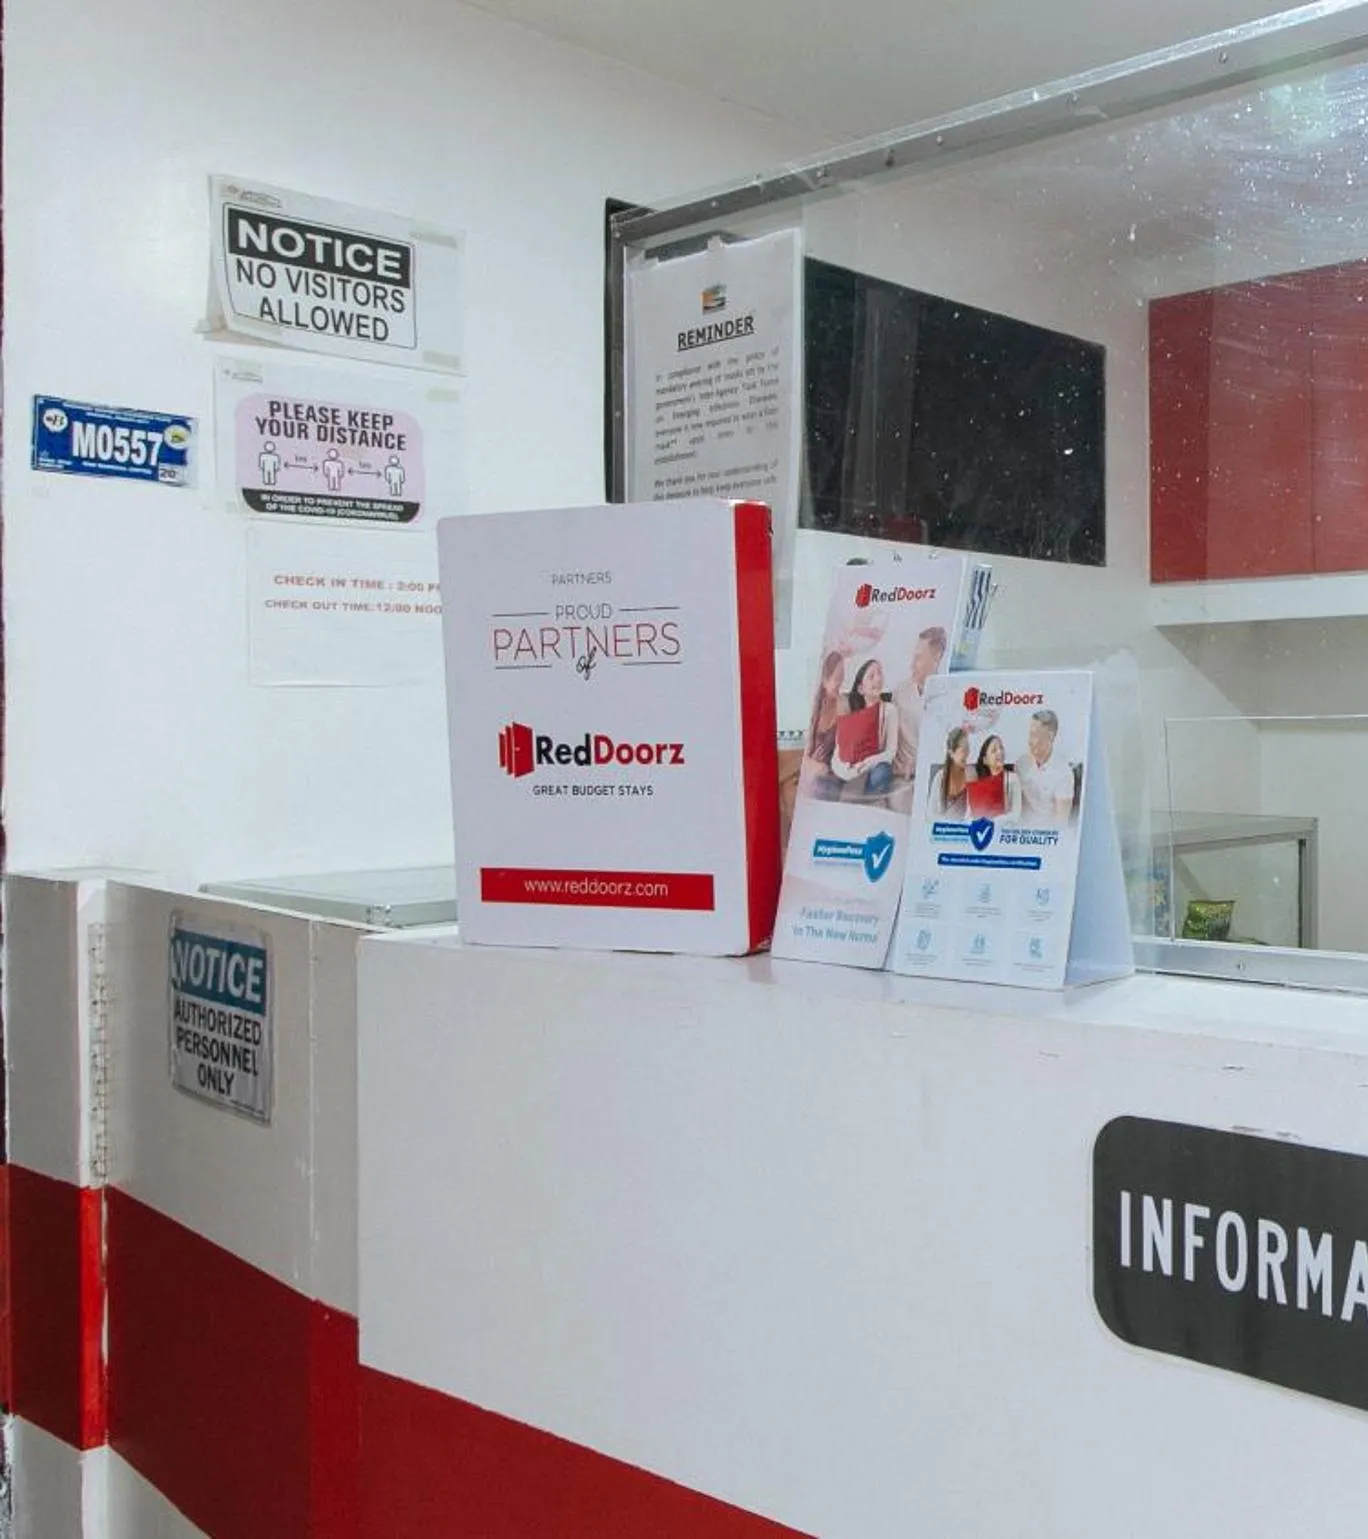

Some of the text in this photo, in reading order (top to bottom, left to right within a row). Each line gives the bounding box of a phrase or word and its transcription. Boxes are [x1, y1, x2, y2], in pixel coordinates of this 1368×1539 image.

[237, 218, 403, 280] NOTICE
[236, 258, 406, 314] NO VISITORS
[259, 296, 389, 342] ALLOWED
[677, 315, 754, 350] REMINDER
[268, 400, 394, 432] PLEASE KEEP
[255, 416, 407, 451] YOUR DISTANCE
[273, 574, 326, 588] CHECK
[331, 578, 346, 589] IN
[352, 578, 385, 590] TIME
[551, 570, 613, 586] PARTNERS
[871, 586, 937, 603] RedDoorz
[264, 598, 308, 610] CHECK
[312, 600, 338, 611] OUT
[555, 604, 613, 621] PROUD
[493, 622, 682, 662] PARTNERS
[575, 647, 598, 681] of
[978, 690, 1044, 706] RedDoorz
[535, 733, 685, 766] RedDoorz
[532, 784, 654, 797] GREAT BUDGET STAYS
[999, 834, 1059, 846] FOR QUALITY
[524, 878, 669, 898] www.reddoorz.com
[171, 938, 264, 1003] NOTICE
[174, 998, 262, 1046] AUTHORIZED
[176, 1027, 260, 1077] PERSONNEL
[196, 1062, 235, 1097] ONLY
